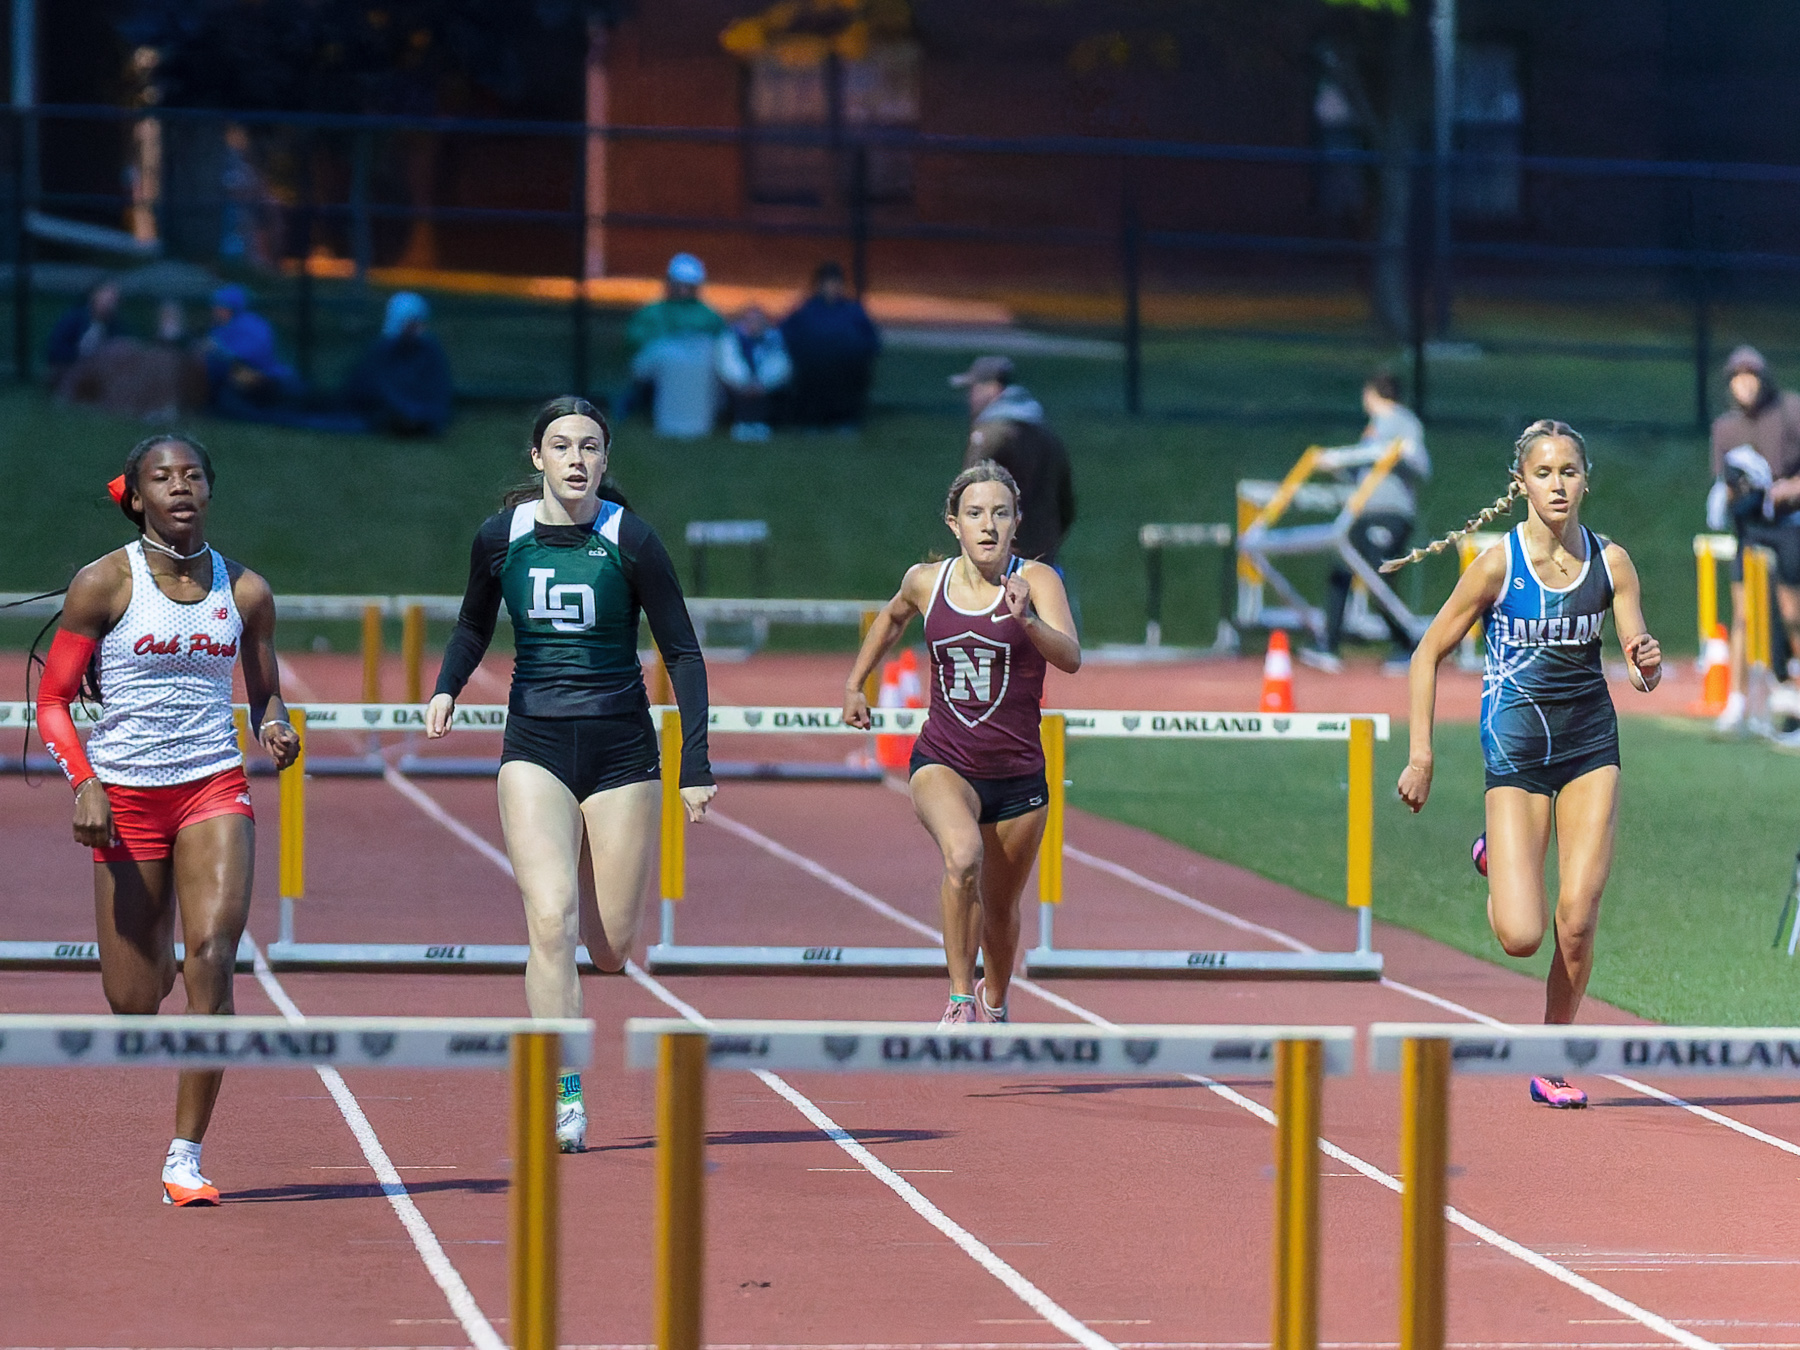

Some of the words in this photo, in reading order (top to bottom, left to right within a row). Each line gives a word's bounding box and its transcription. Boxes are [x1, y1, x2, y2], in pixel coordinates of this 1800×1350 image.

[527, 567, 596, 632] LO
[133, 633, 181, 656] Oak
[189, 633, 237, 658] Park
[946, 647, 996, 702] N
[393, 709, 503, 725] OAAND
[773, 714, 884, 728] OAKLD
[1151, 717, 1262, 732] OAKLAND
[55, 944, 95, 957] GILL
[424, 946, 465, 959] GILL
[803, 947, 843, 960] GILL
[115, 1029, 338, 1057] OAKLAND
[882, 1035, 1100, 1063] OAKLAND
